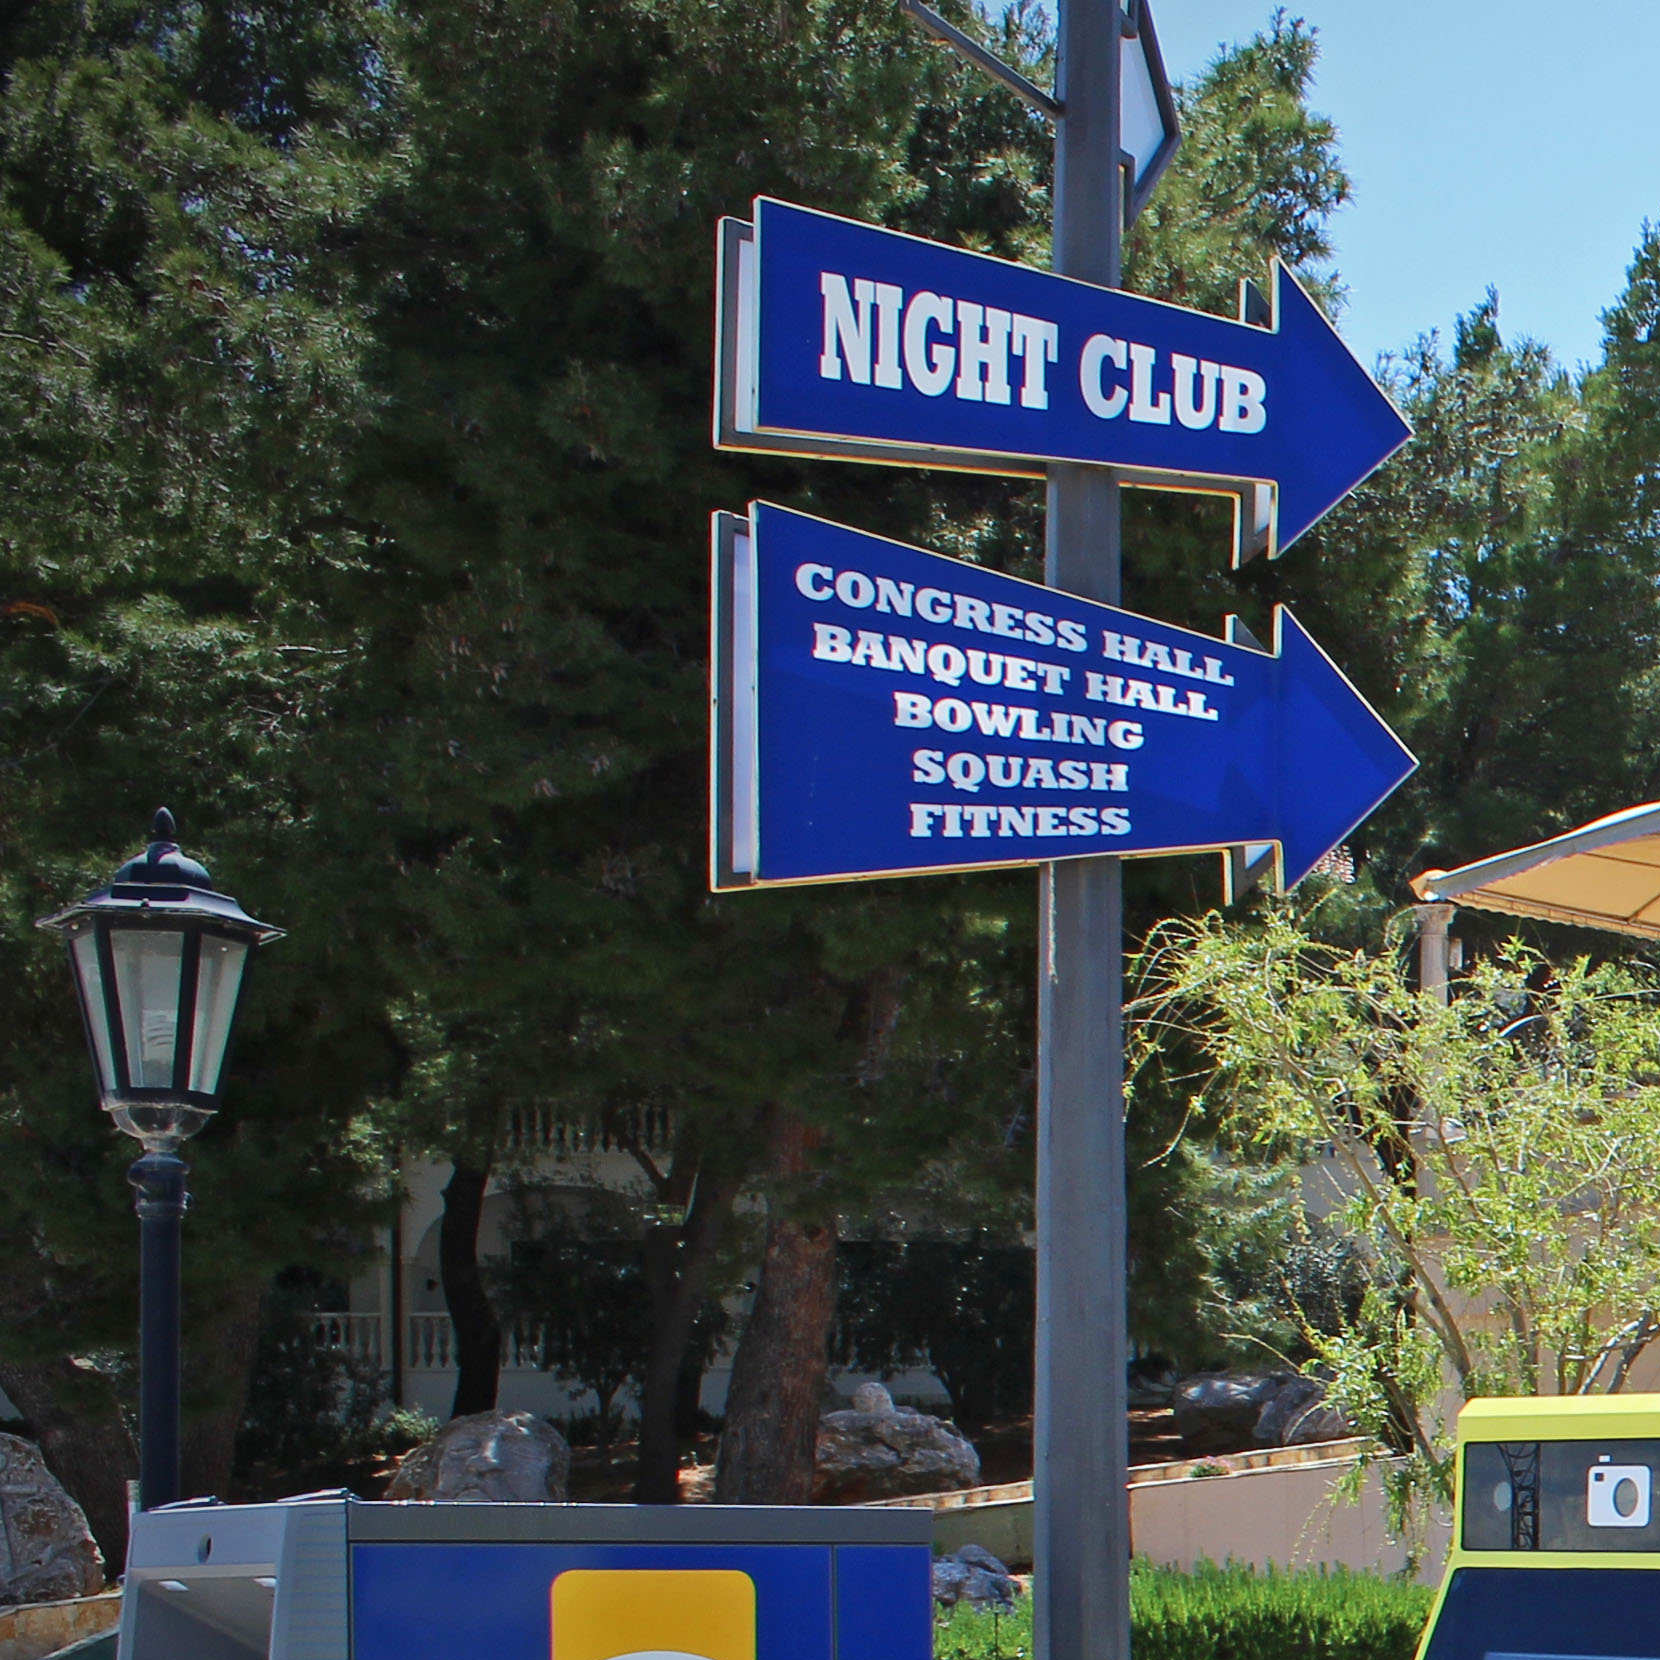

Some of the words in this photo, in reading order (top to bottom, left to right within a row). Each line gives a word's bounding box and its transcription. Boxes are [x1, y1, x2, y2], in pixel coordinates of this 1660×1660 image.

[820, 271, 1058, 410] NIGHT
[1080, 334, 1267, 434] CLUB
[796, 564, 1087, 652] CONGRESS
[1103, 630, 1235, 686] HALL
[813, 622, 1071, 696] BANQUET
[1086, 671, 1219, 721] HALL
[894, 691, 1144, 750] BOWLING
[913, 750, 1129, 793] SQUASH
[910, 803, 1132, 838] FITNESS
